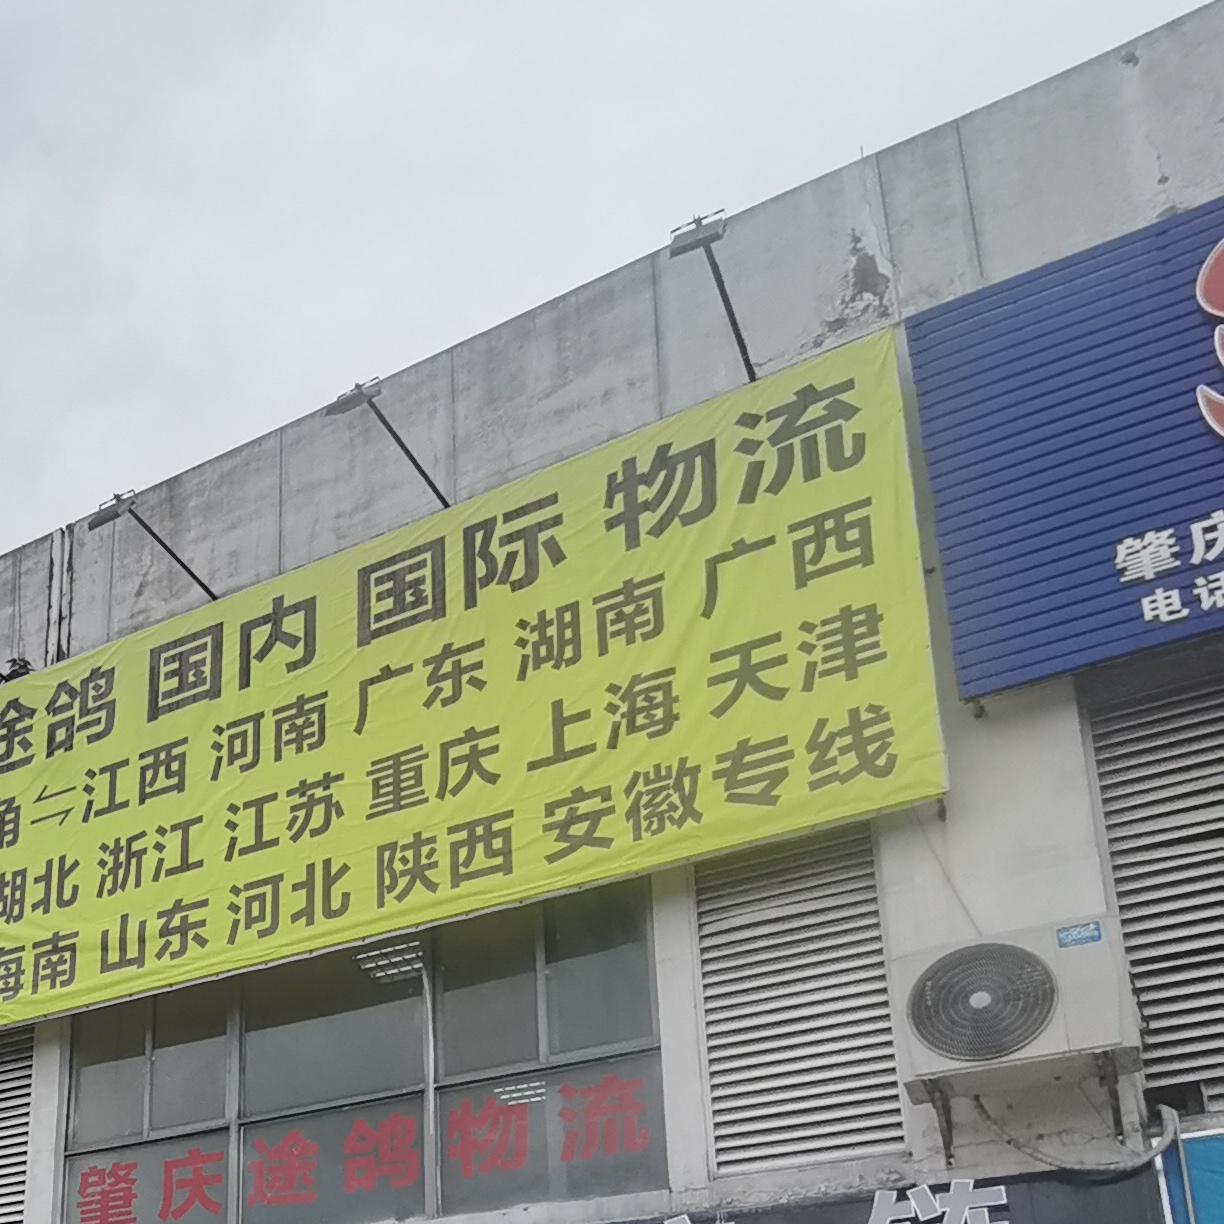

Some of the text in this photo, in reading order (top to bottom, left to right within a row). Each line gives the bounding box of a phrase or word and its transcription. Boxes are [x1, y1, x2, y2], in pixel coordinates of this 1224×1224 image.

[82, 737, 188, 823] 江西
[210, 690, 329, 781] 河南
[354, 638, 487, 735] 广东
[513, 571, 665, 681] 湖南
[700, 497, 875, 619] 广西
[147, 594, 317, 724] 国内
[357, 492, 567, 648] 国际
[603, 377, 866, 550] 物流
[96, 815, 204, 899] 浙江
[224, 771, 345, 862] 江苏
[365, 725, 501, 821] 重庆
[526, 666, 680, 773] 上海
[707, 603, 888, 719] 天津
[99, 899, 209, 975] 山东
[226, 859, 351, 946] 河北
[376, 809, 515, 909] 陕西
[542, 702, 898, 864] 安徽专线
